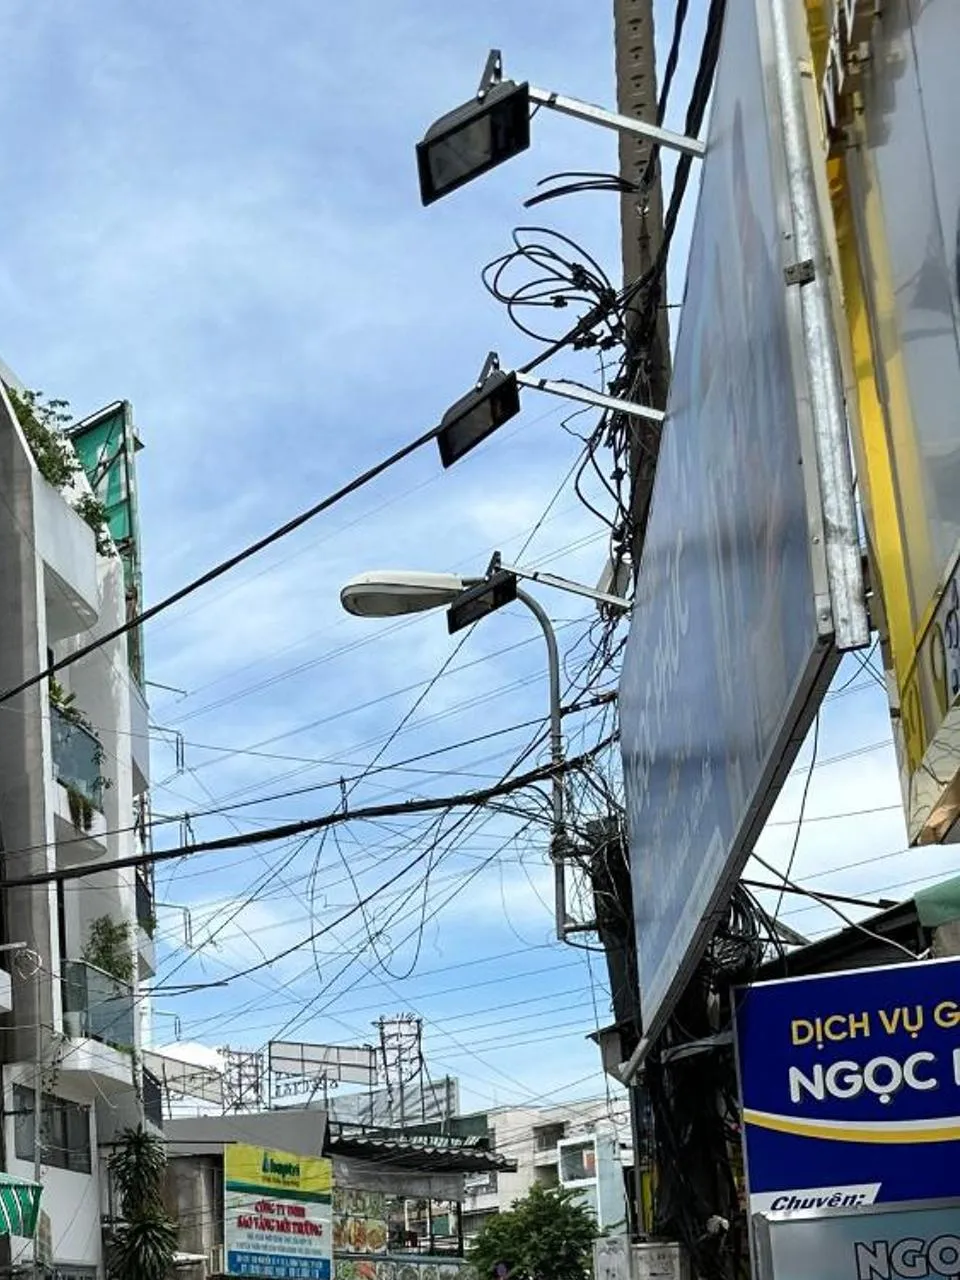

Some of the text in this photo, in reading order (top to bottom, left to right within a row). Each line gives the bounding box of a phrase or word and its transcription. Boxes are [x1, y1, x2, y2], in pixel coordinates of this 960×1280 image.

[791, 1012, 870, 1050] DỊCH
[877, 1005, 924, 1039] VỤ
[788, 1051, 938, 1104] NGỌC
